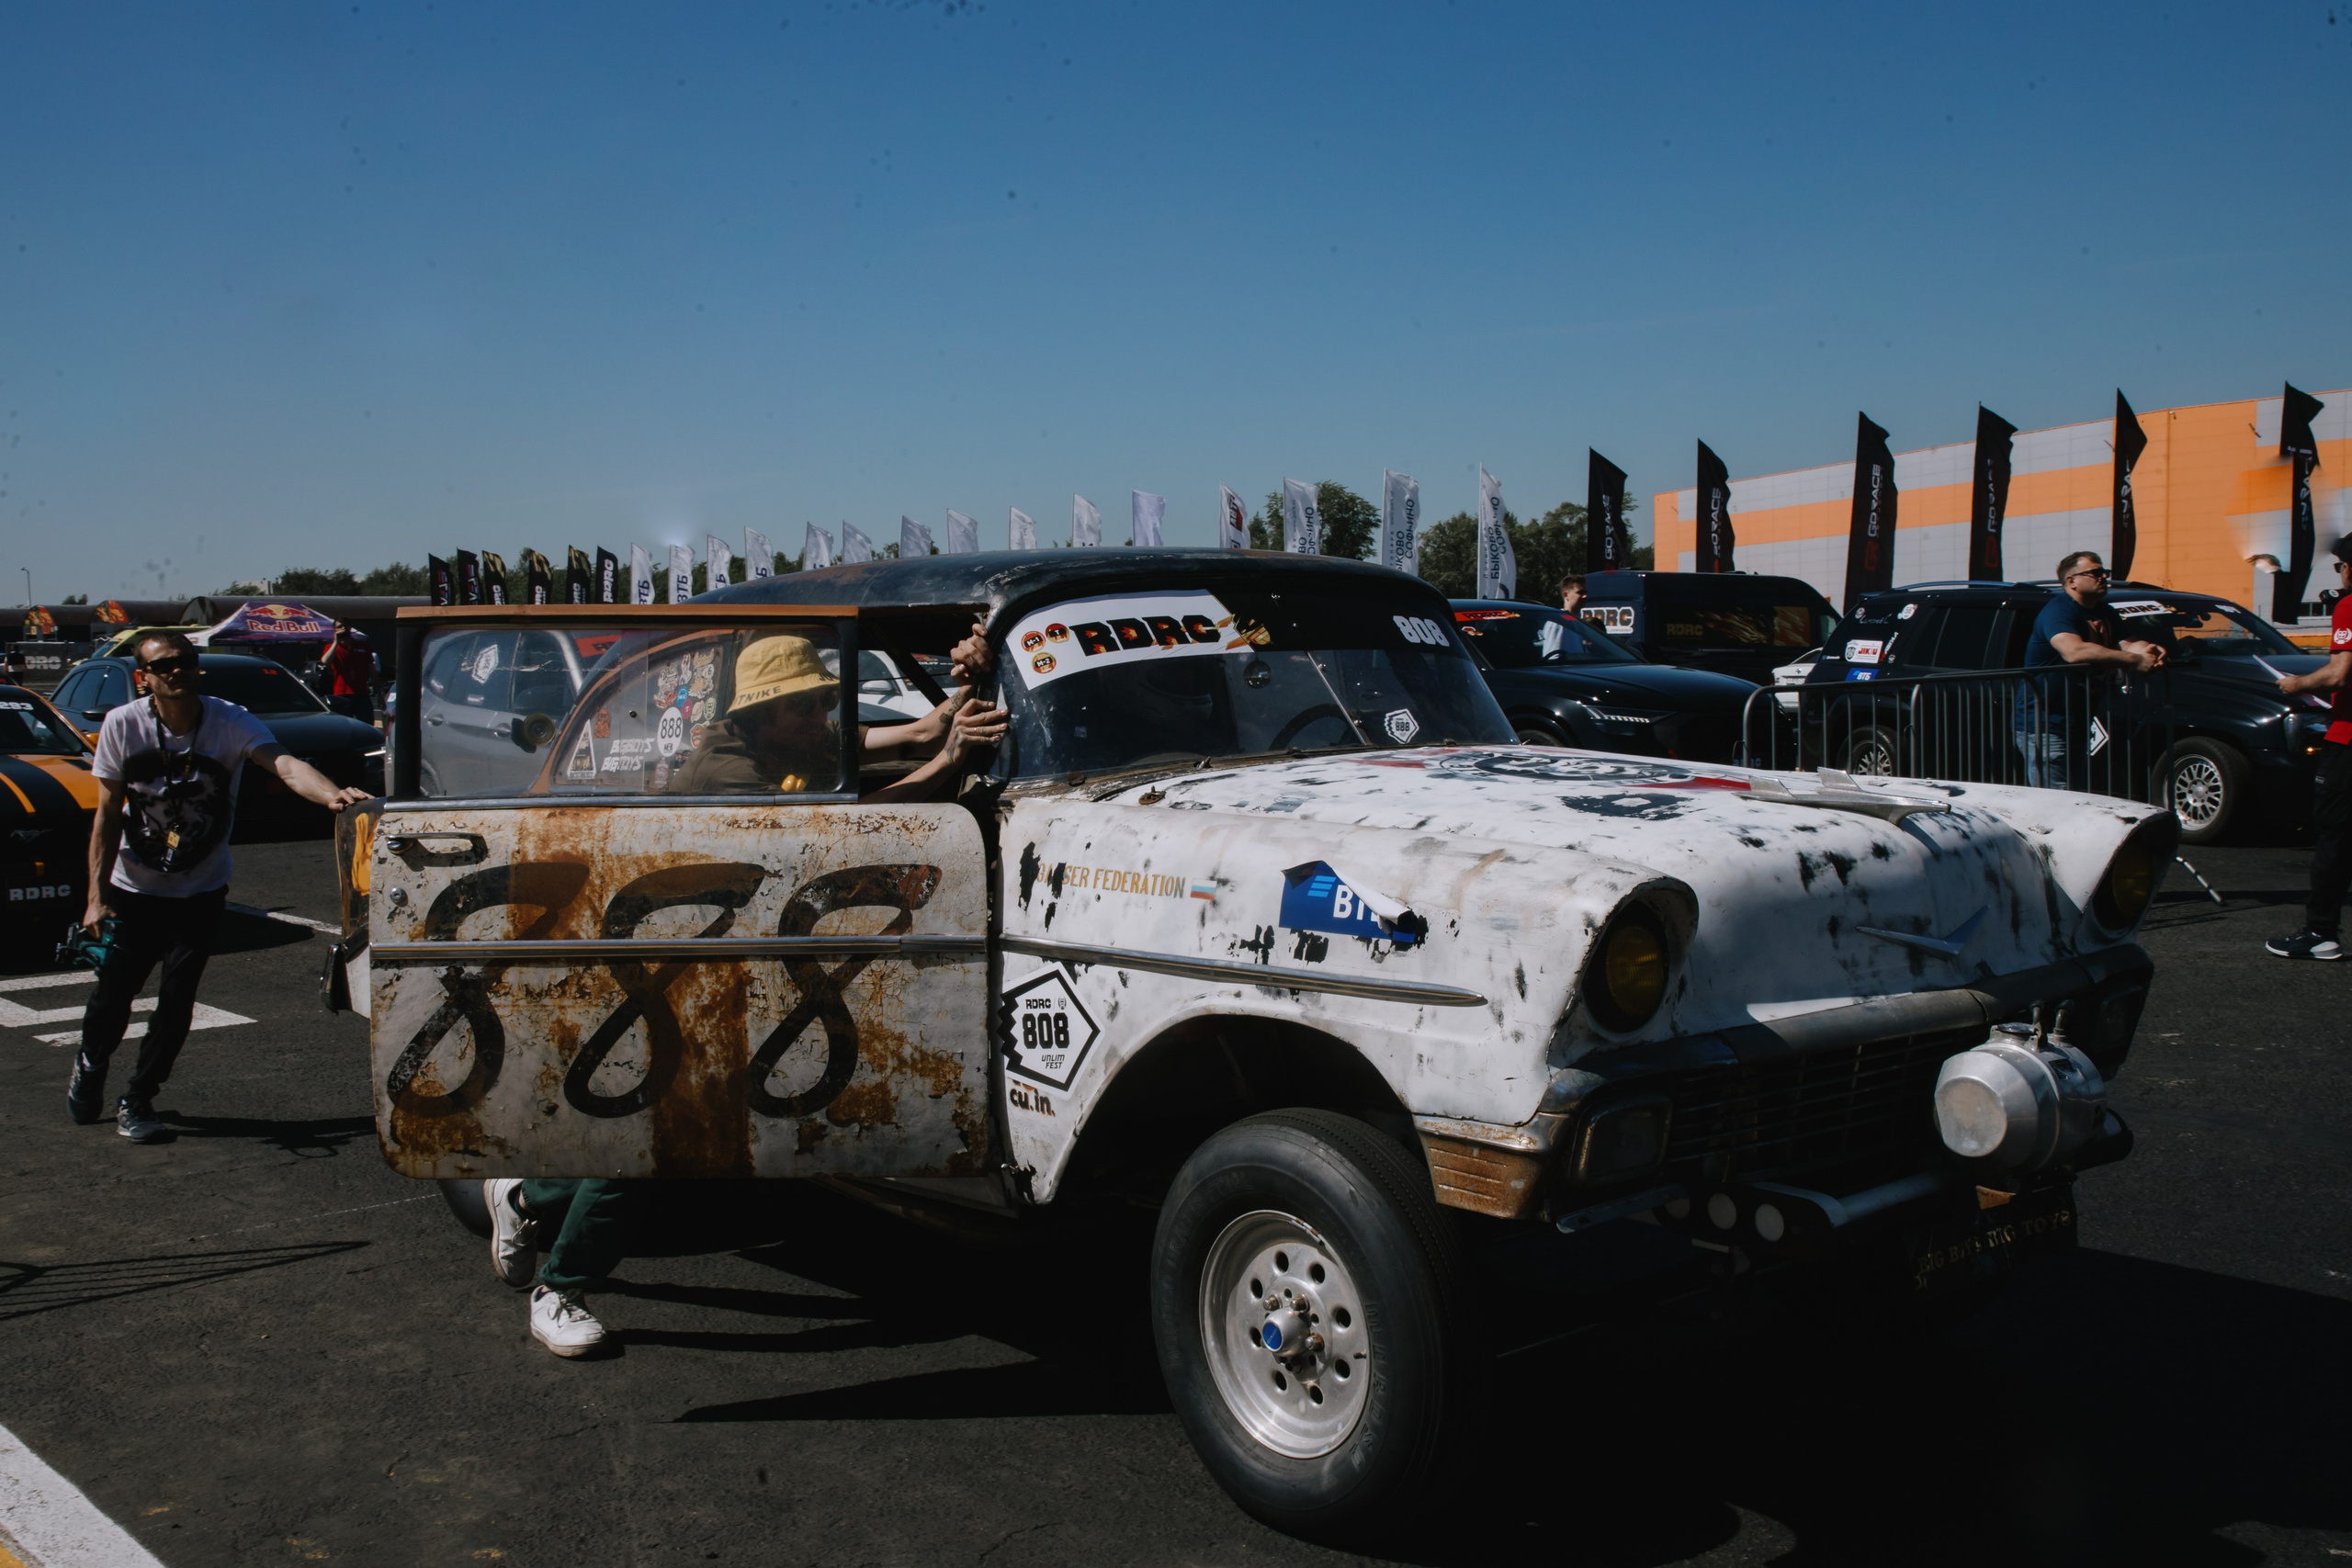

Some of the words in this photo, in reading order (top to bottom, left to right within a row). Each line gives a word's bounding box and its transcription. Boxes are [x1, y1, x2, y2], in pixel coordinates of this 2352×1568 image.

[1871, 463, 1881, 508] RACE
[1711, 487, 1722, 532] RACE
[1867, 513, 1878, 536] GO
[1396, 531, 1405, 571] ЫКОВО
[1604, 537, 1613, 560] GO
[246, 619, 284, 633] Red
[286, 621, 322, 633] Bull
[1069, 615, 1222, 657] RDRC
[1392, 615, 1451, 648] 808
[1667, 624, 1703, 637] RDRC
[1026, 637, 1041, 646] M-1
[25, 656, 62, 670] DRC
[1036, 658, 1050, 668] M-2
[1857, 671, 1872, 681] ВТБ
[734, 685, 781, 705] TNIKE
[661, 716, 683, 739] 888
[1037, 863, 1091, 888] GASER
[1093, 868, 1186, 898] FEDERATION
[9, 884, 72, 902] RDRC
[388, 862, 943, 1119] 888
[1025, 998, 1052, 1010] RDRC
[1022, 1012, 1070, 1049] 808
[1010, 1088, 1056, 1117] cu.in.
[2022, 1210, 2073, 1237] TOYS
